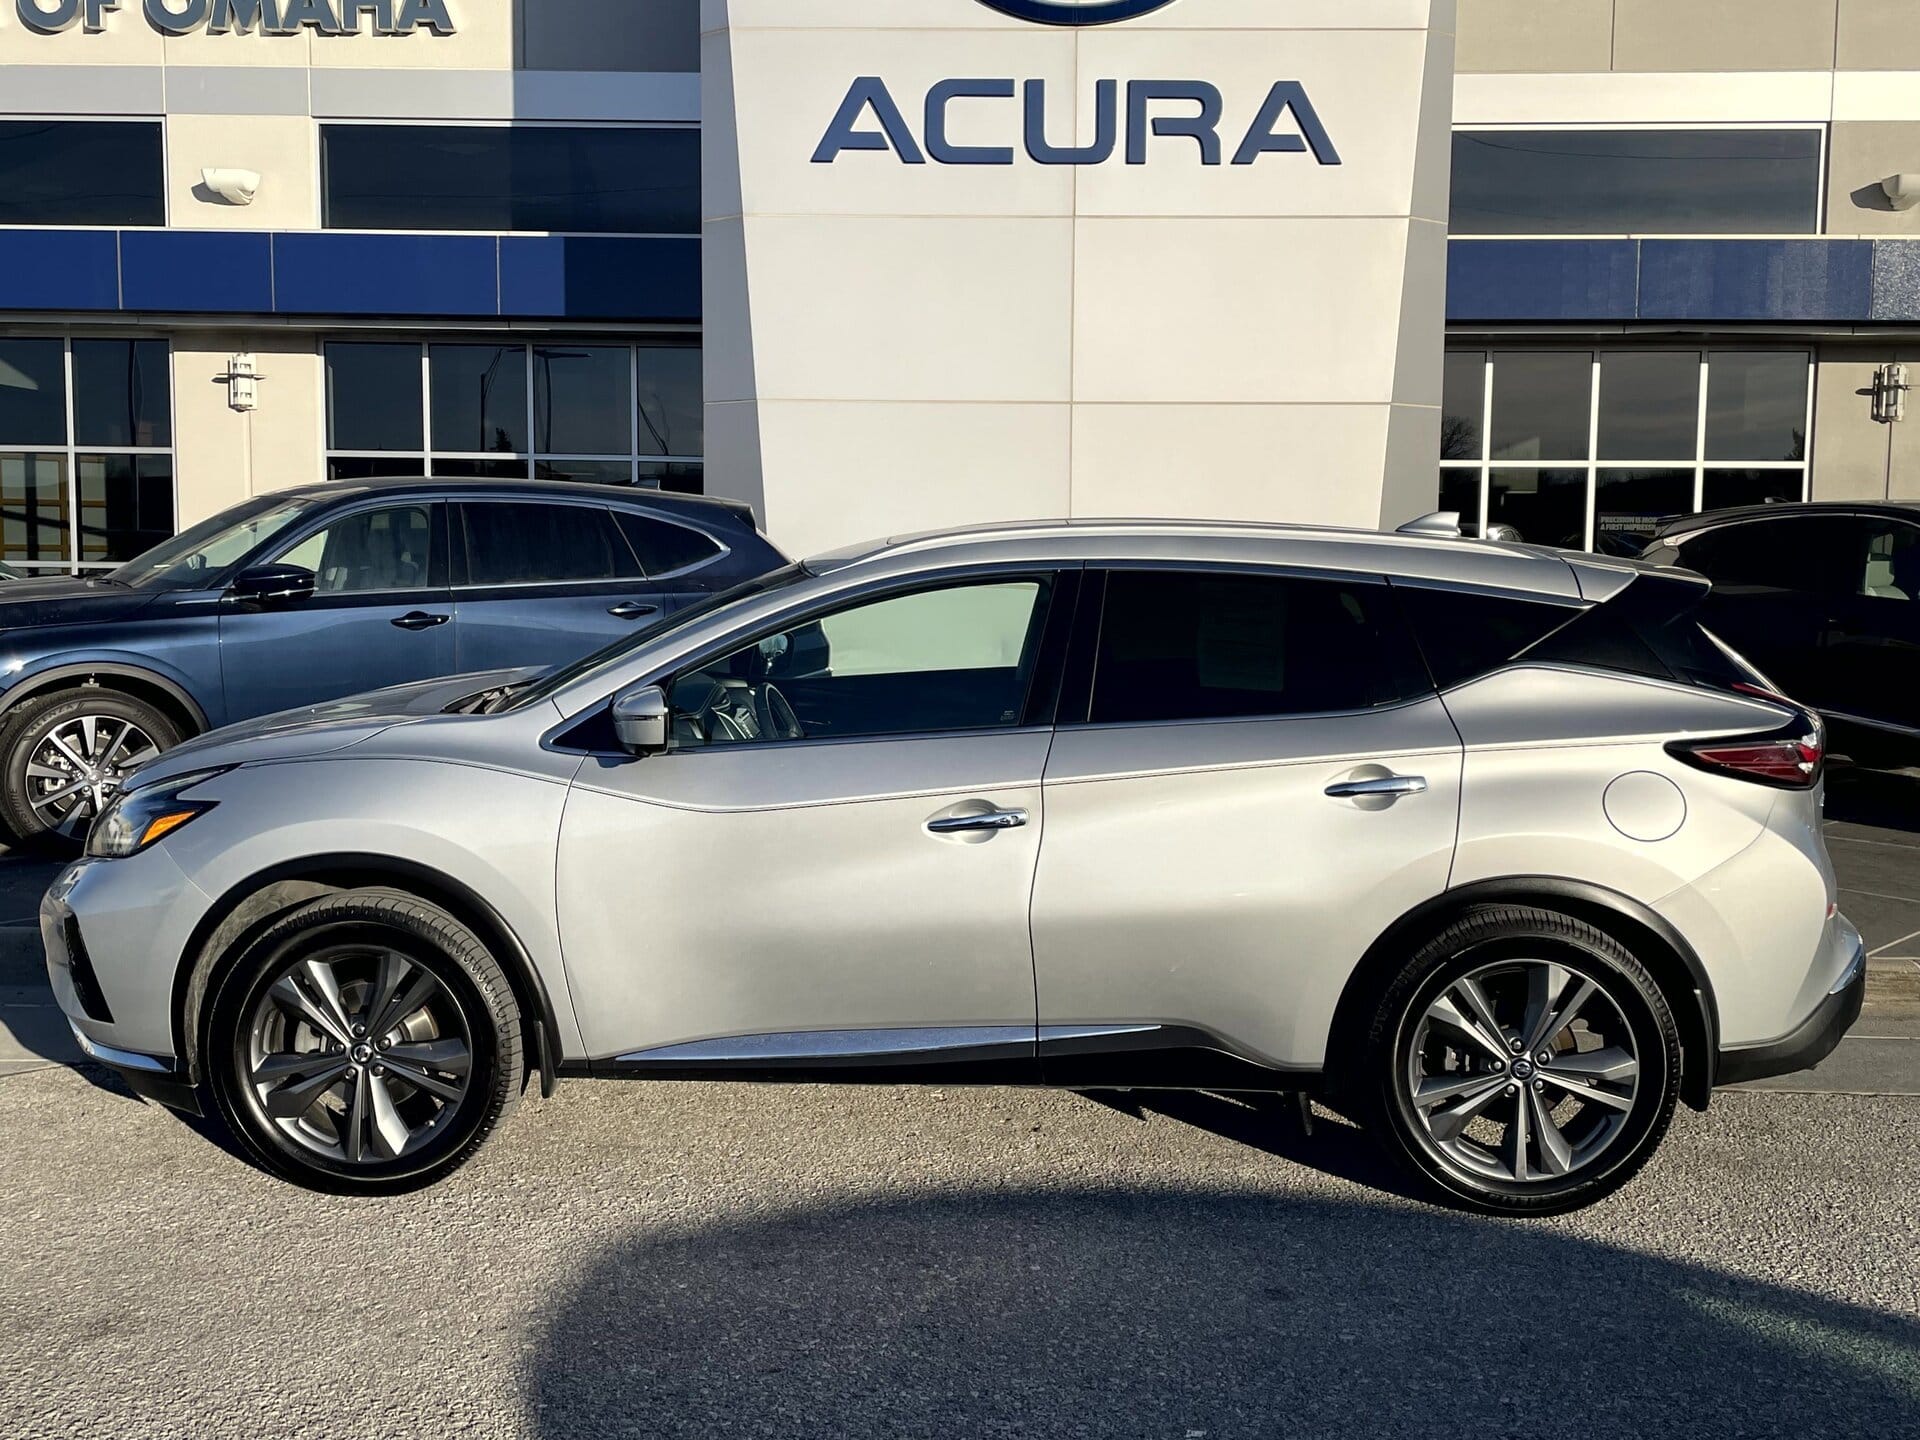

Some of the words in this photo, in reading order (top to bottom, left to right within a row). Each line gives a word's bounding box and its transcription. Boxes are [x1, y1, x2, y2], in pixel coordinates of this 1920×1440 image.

[16, 0, 121, 35] OF
[143, 0, 457, 37] OMAHA
[810, 76, 1342, 165] ACURA
[1600, 516, 1634, 524] PRECISION
